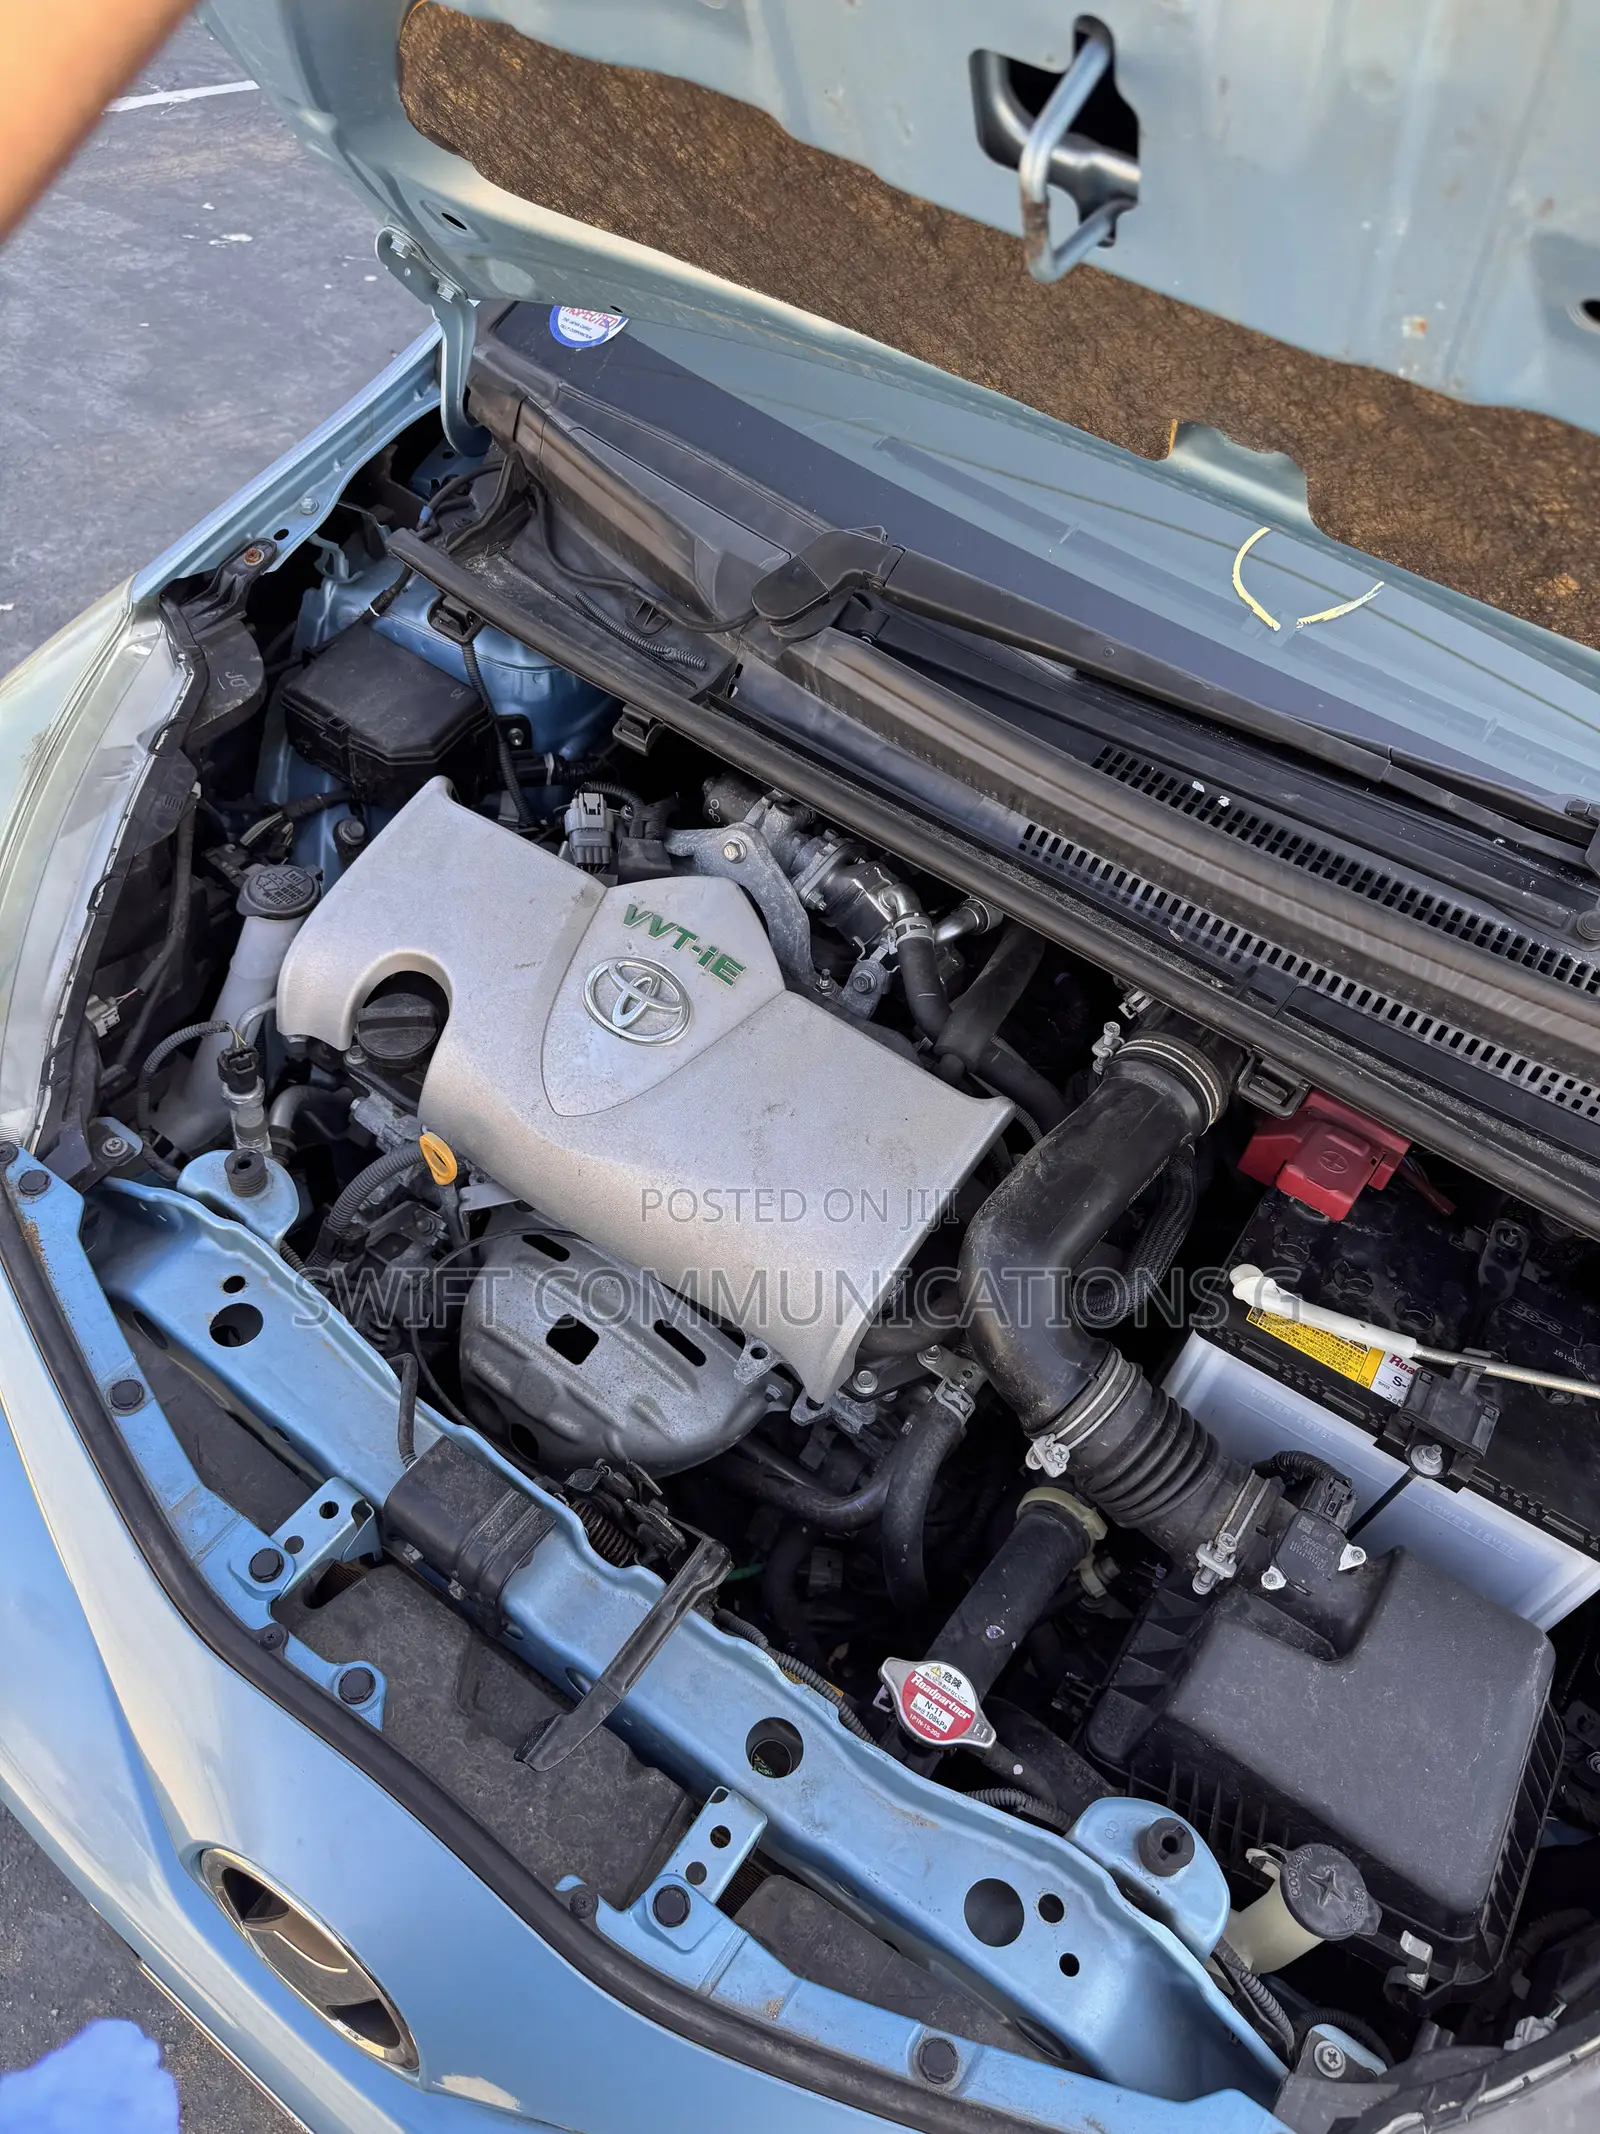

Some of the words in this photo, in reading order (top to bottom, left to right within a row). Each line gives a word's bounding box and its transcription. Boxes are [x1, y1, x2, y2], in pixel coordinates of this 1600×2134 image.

[623, 903, 747, 989] VVT-iE
[1388, 1354, 1416, 1374] Roa
[1424, 1500, 1472, 1530] LOWER
[1474, 1528, 1515, 1556] LEVEL
[910, 1673, 971, 1720] Roadpartner
[924, 1701, 943, 1717] N-11
[925, 1712, 948, 1730] 108kPa
[1288, 1847, 1313, 1899] COOLANT
